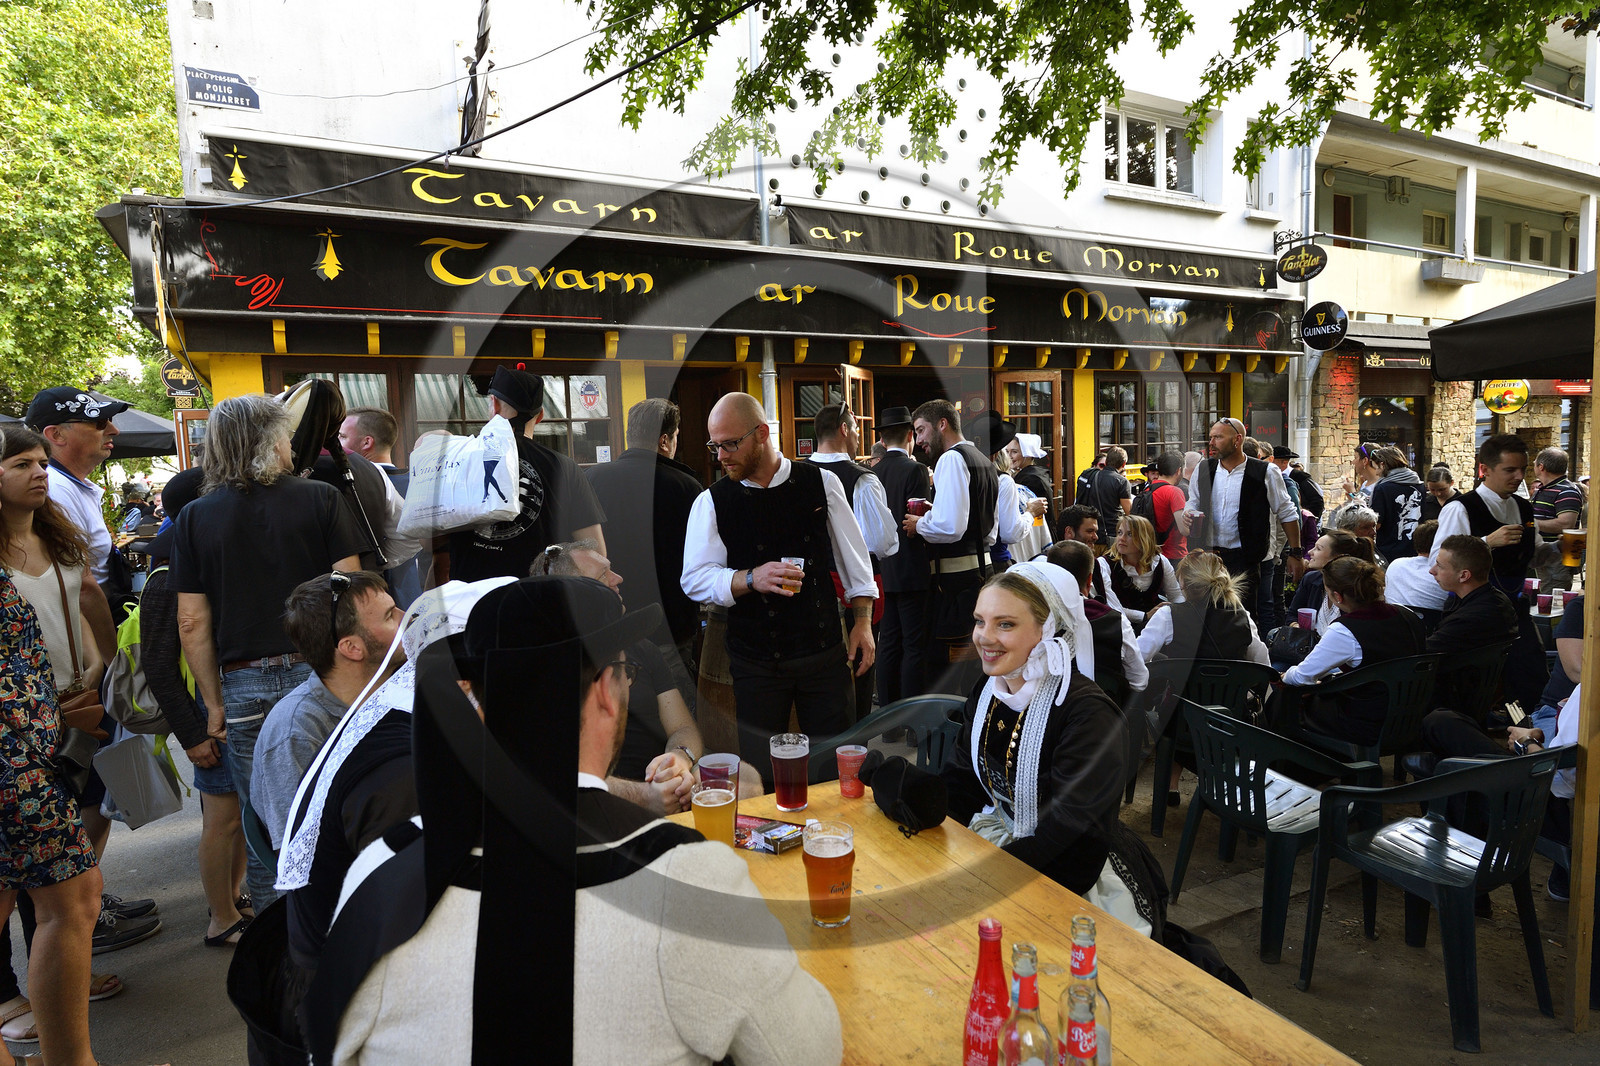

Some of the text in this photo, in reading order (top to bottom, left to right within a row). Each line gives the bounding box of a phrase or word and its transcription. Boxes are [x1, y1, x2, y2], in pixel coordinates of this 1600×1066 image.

[205, 84, 233, 94] POLIG
[195, 92, 250, 106] MONJARRET
[403, 167, 1220, 279] Tavarn ar Roue Morvan
[421, 237, 1187, 326] Tavarn ar Roue Morvan
[1304, 324, 1341, 337] GUINNESS
